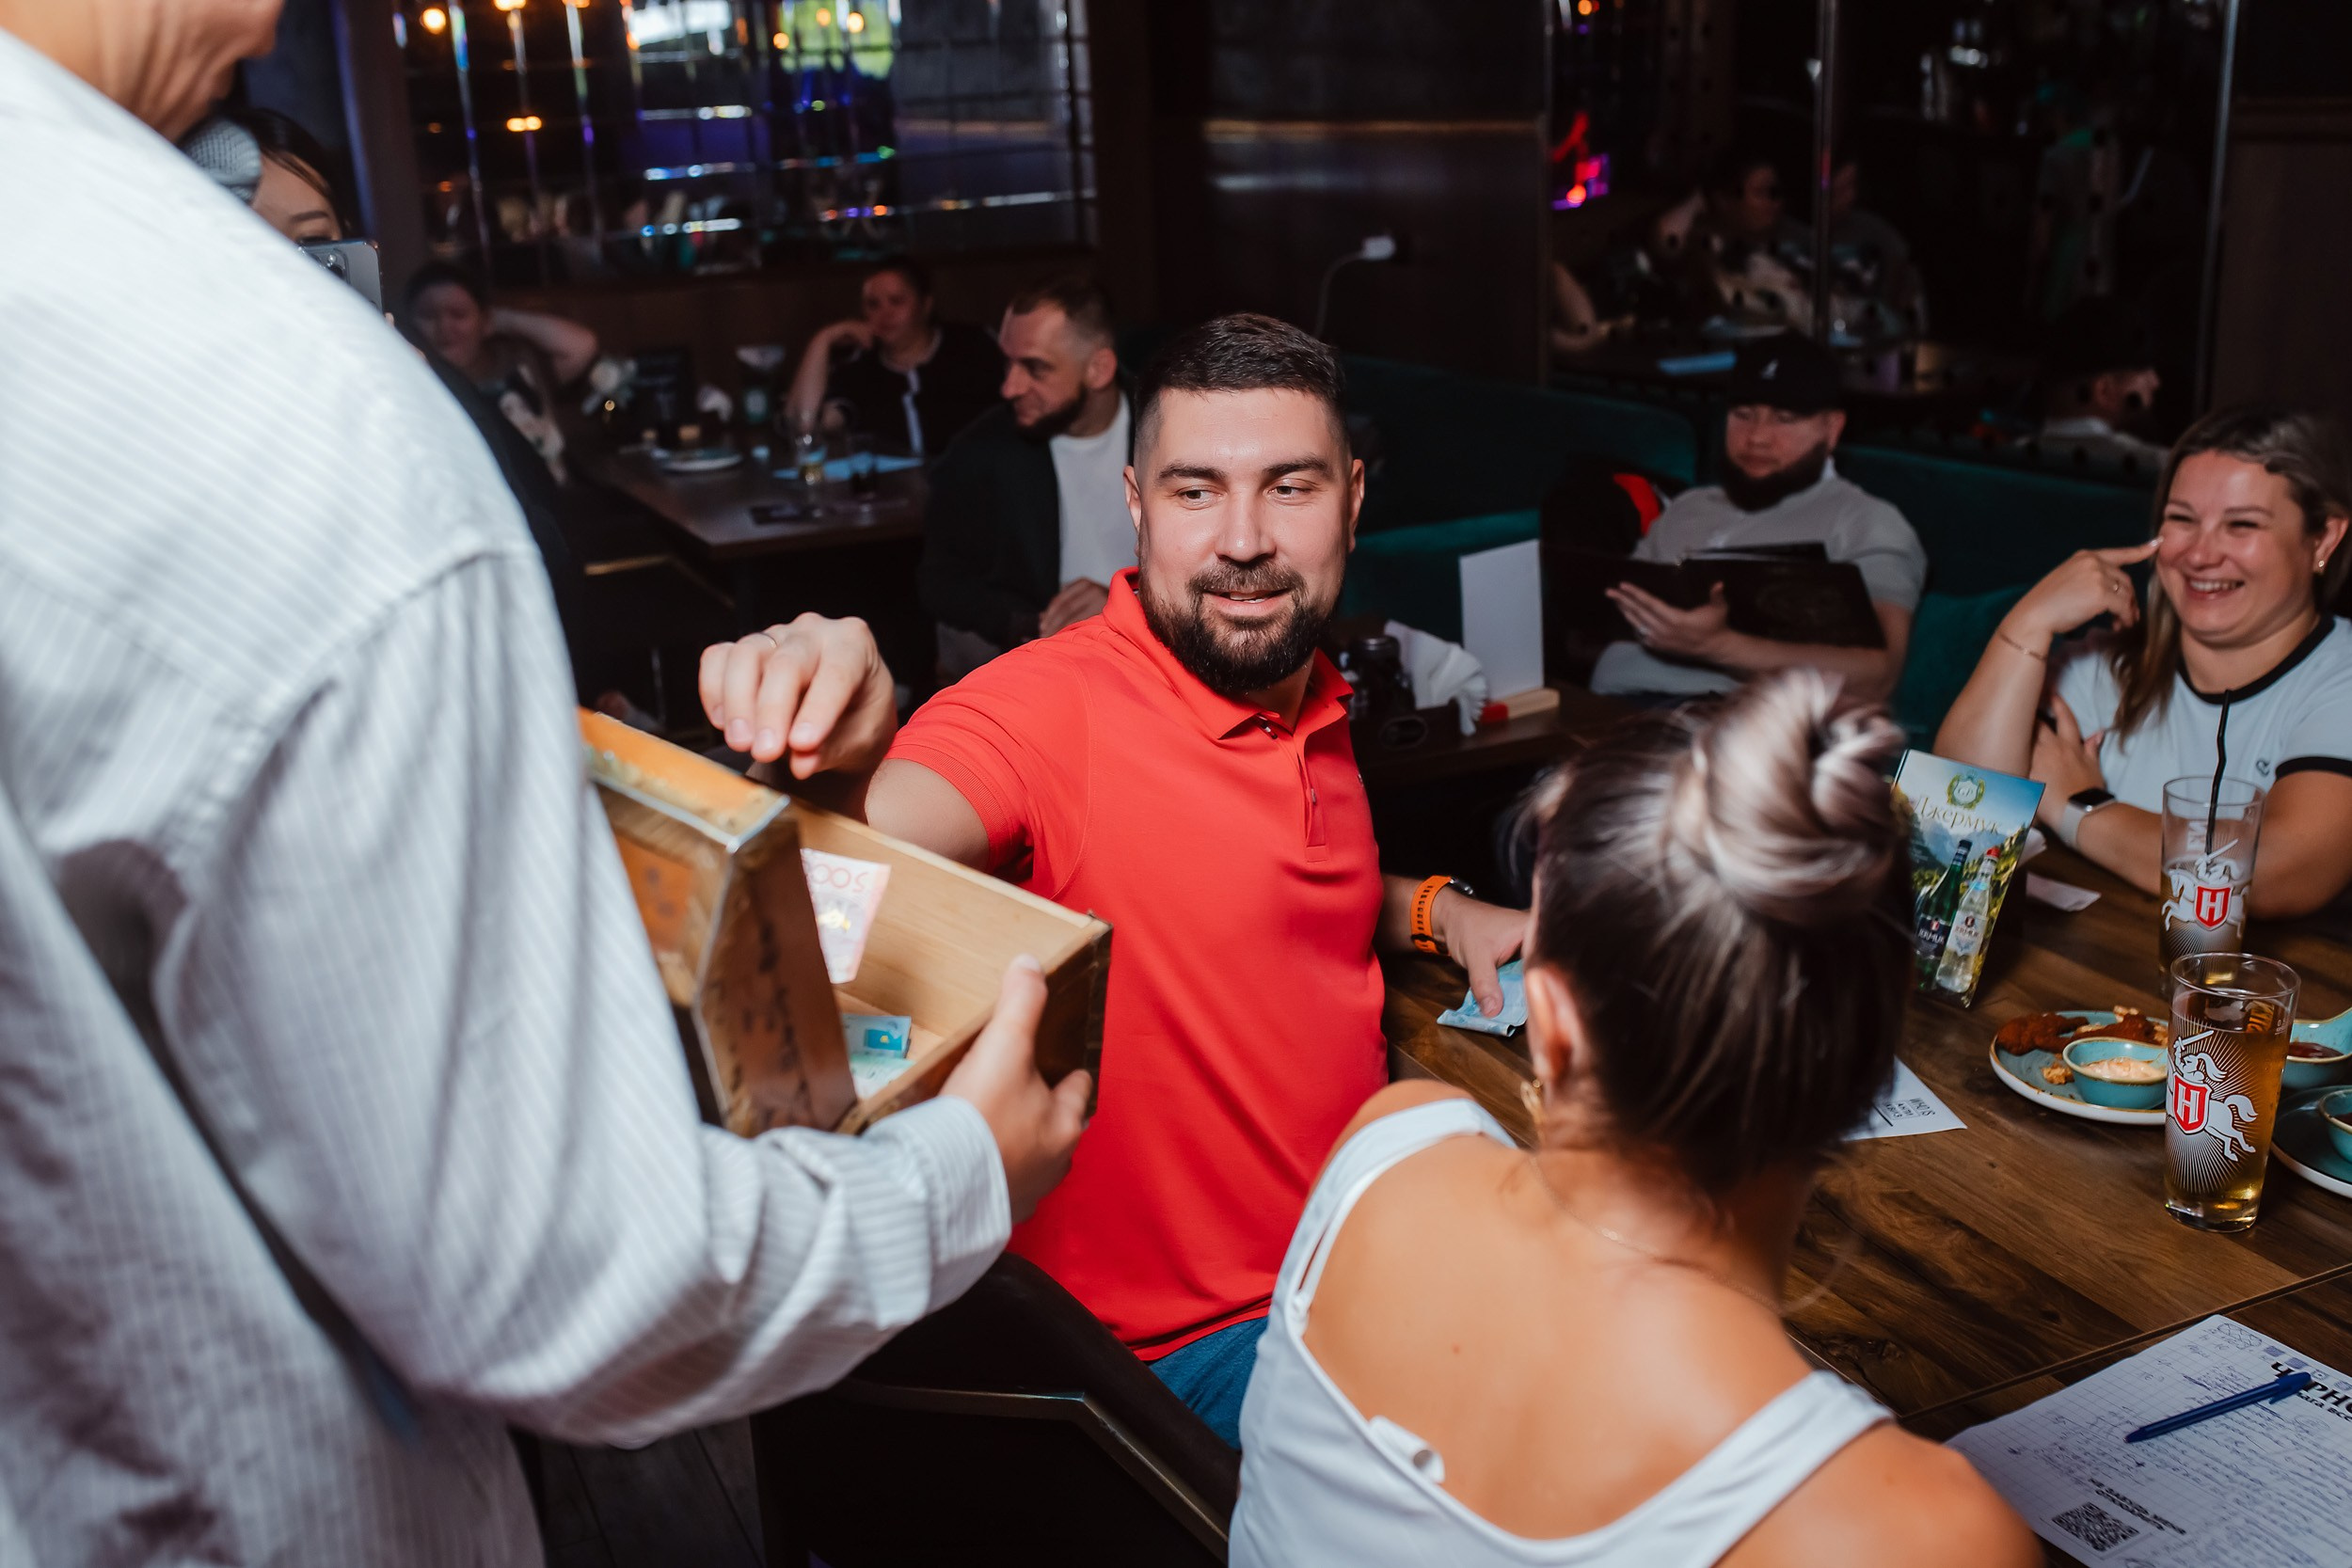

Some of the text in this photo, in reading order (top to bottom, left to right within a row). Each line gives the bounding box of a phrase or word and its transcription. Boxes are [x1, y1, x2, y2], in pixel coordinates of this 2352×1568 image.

[2200, 890, 2225, 922] H
[2176, 1083, 2200, 1124] H
[2271, 1361, 2352, 1414] ЧРН
